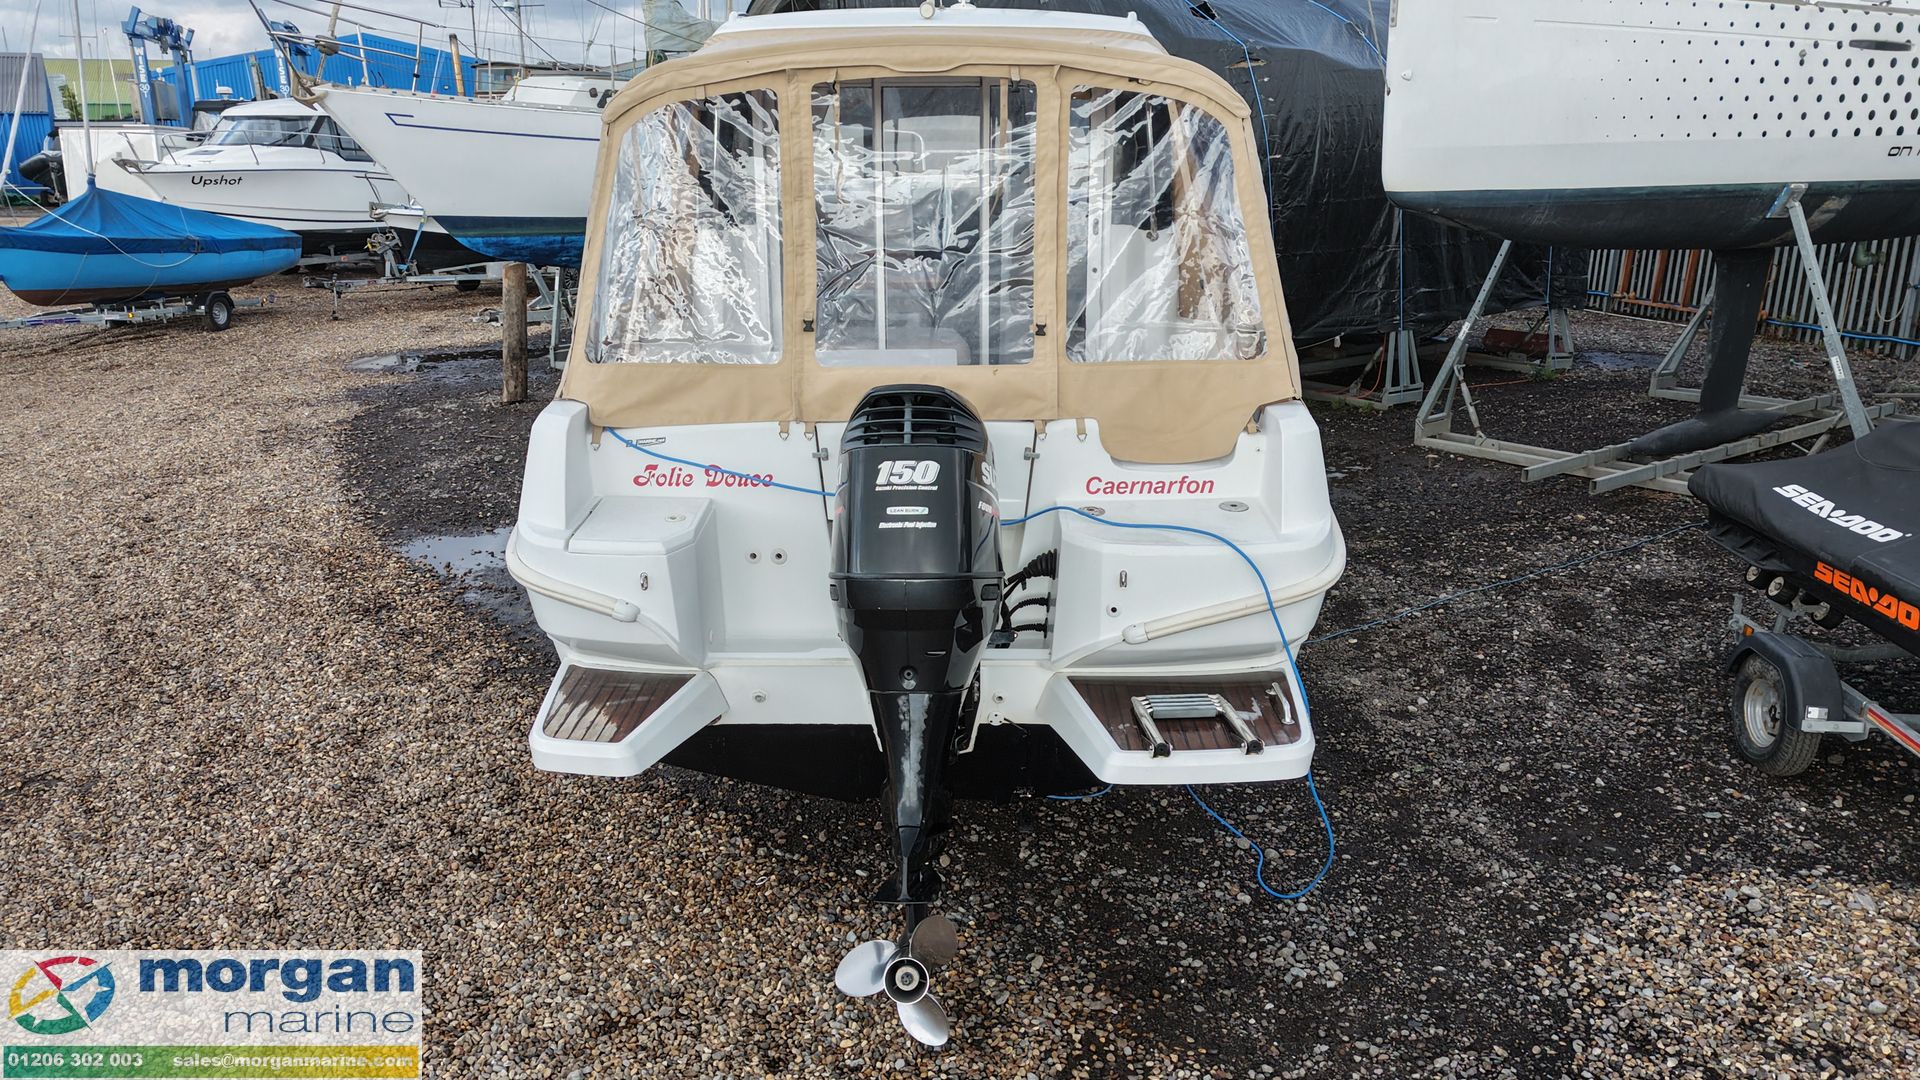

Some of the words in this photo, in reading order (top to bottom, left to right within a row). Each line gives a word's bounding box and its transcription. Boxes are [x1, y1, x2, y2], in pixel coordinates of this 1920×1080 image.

[133, 46, 147, 83] WISE
[191, 174, 243, 188] Upshot
[632, 463, 694, 488] Folie
[704, 463, 774, 488] Douce
[875, 460, 941, 486] 150
[1085, 475, 1215, 495] Caernarfon
